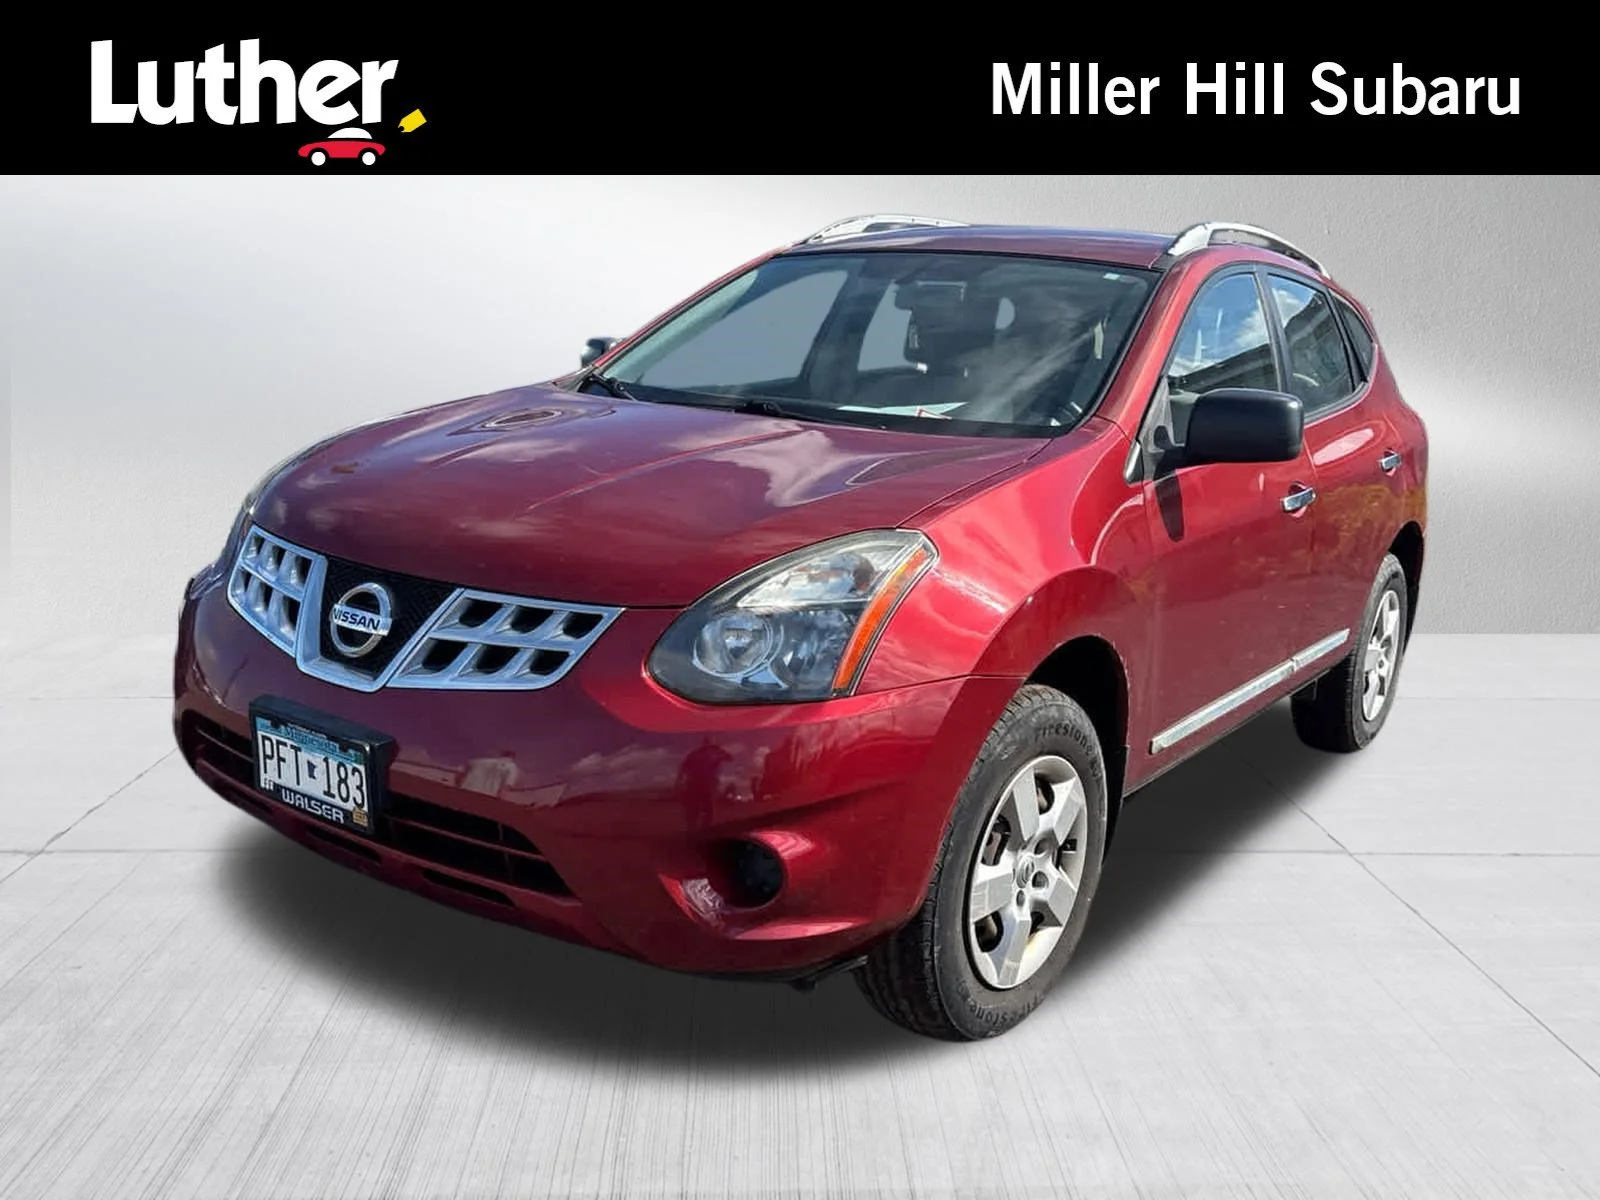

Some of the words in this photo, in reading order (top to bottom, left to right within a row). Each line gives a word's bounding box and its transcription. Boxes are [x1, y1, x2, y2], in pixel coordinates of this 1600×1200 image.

[333, 607, 381, 631] NISSAN
[261, 734, 303, 787] PFT
[322, 756, 366, 808] 183
[281, 788, 345, 825] WALSER
